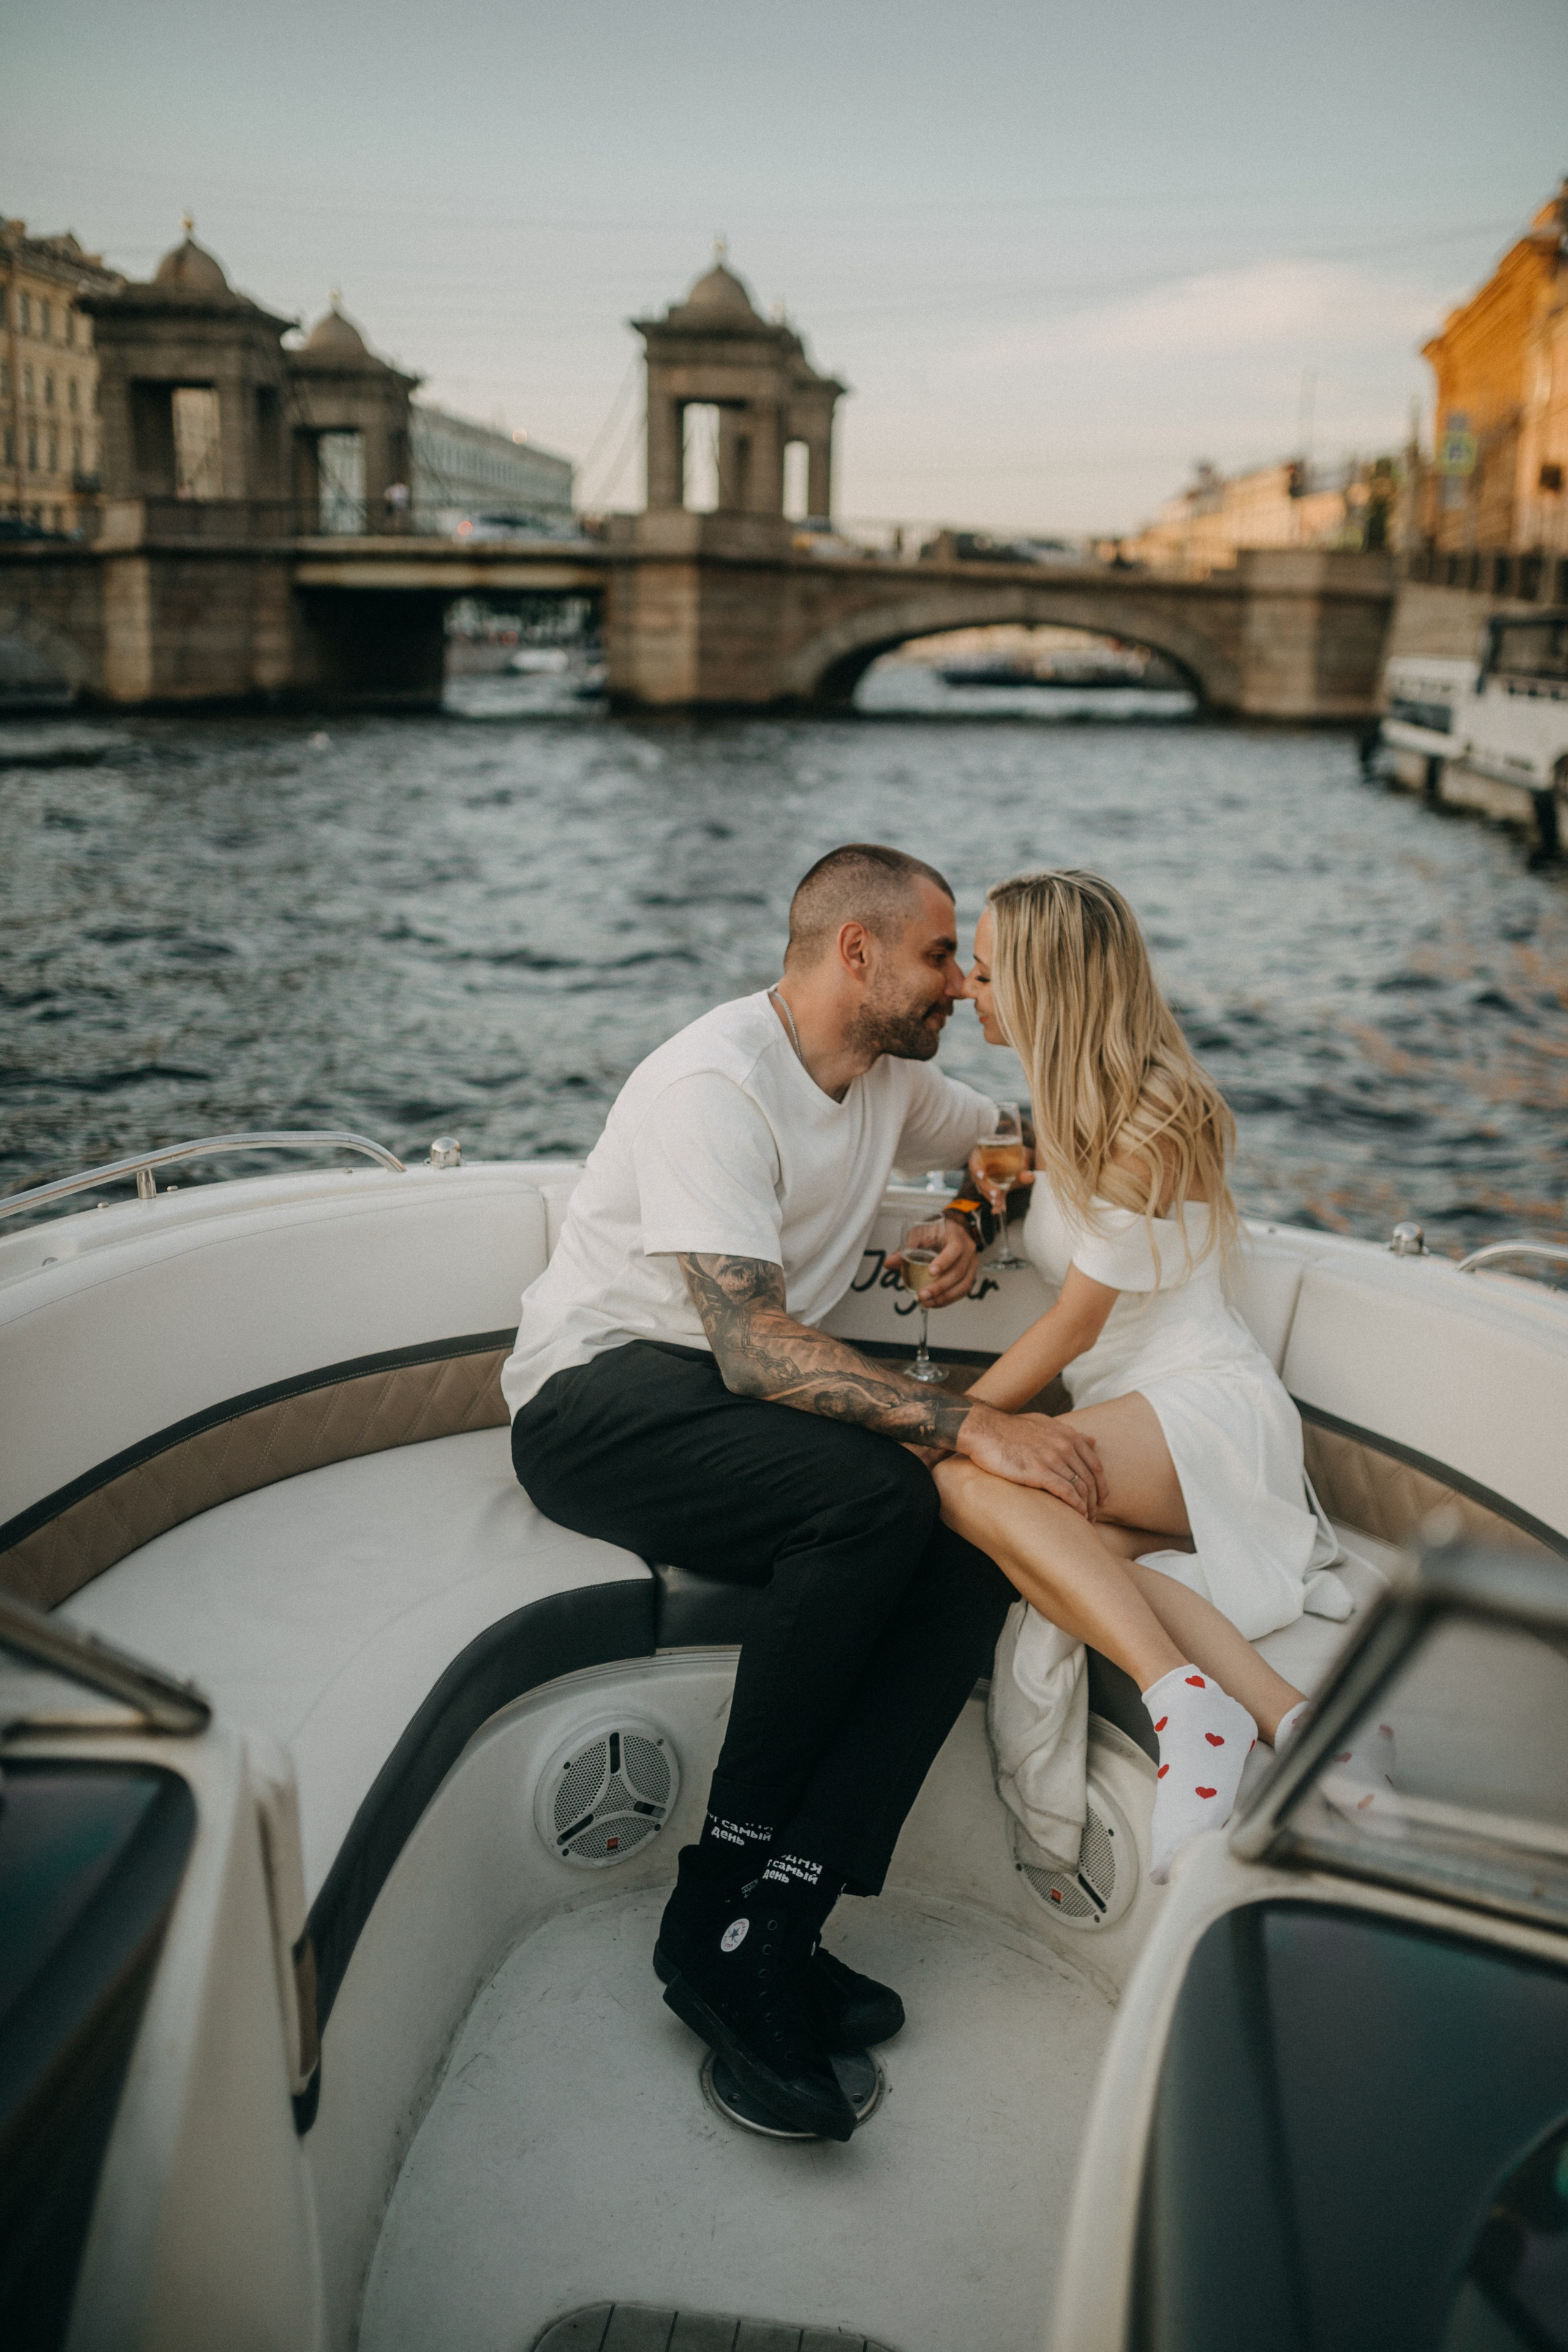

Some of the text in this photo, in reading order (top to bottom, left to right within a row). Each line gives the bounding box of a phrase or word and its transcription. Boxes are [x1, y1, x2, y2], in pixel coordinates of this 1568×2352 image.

[710, 1826, 745, 1846] день
[721, 1819, 772, 1842] самый
[762, 1869, 790, 1883] день
[772, 1860, 819, 1885] самый
